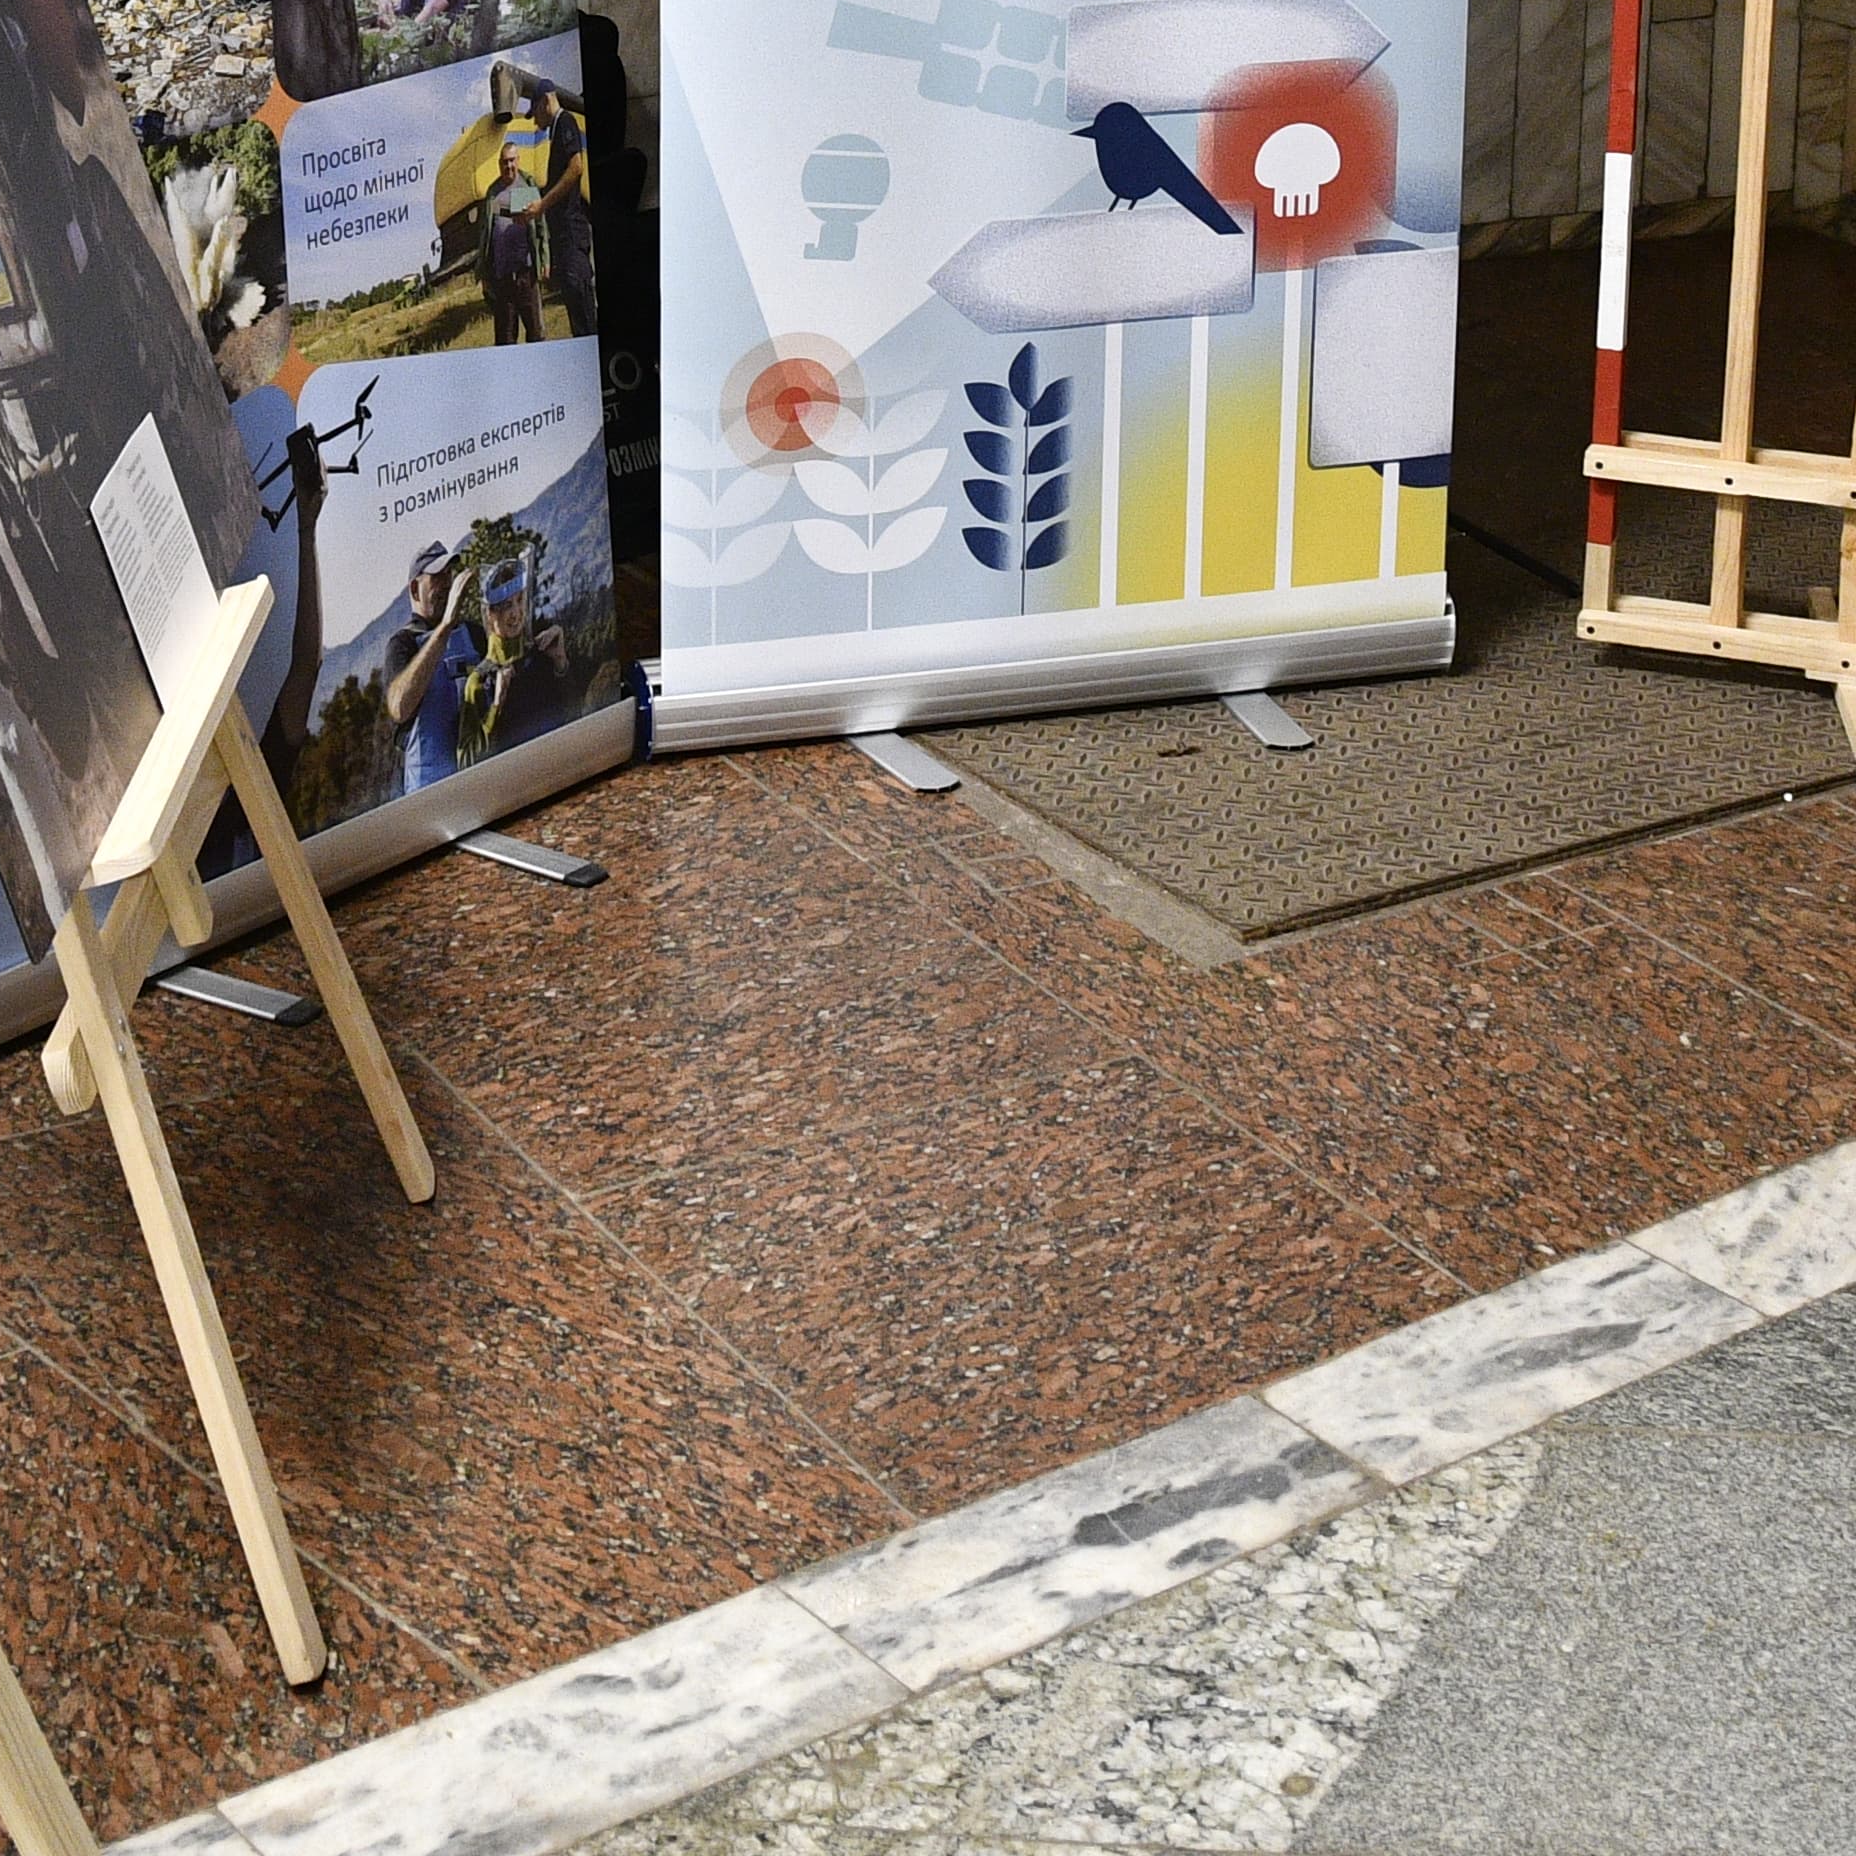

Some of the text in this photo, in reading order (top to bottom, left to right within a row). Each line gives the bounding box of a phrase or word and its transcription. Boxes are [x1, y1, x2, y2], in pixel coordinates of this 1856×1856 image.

[301, 137, 387, 178] Просвіта
[303, 157, 426, 216] щодо мінної
[306, 204, 410, 250] небезпеки
[376, 403, 567, 488] Підготовка експертів
[378, 455, 521, 523] з розмінування
